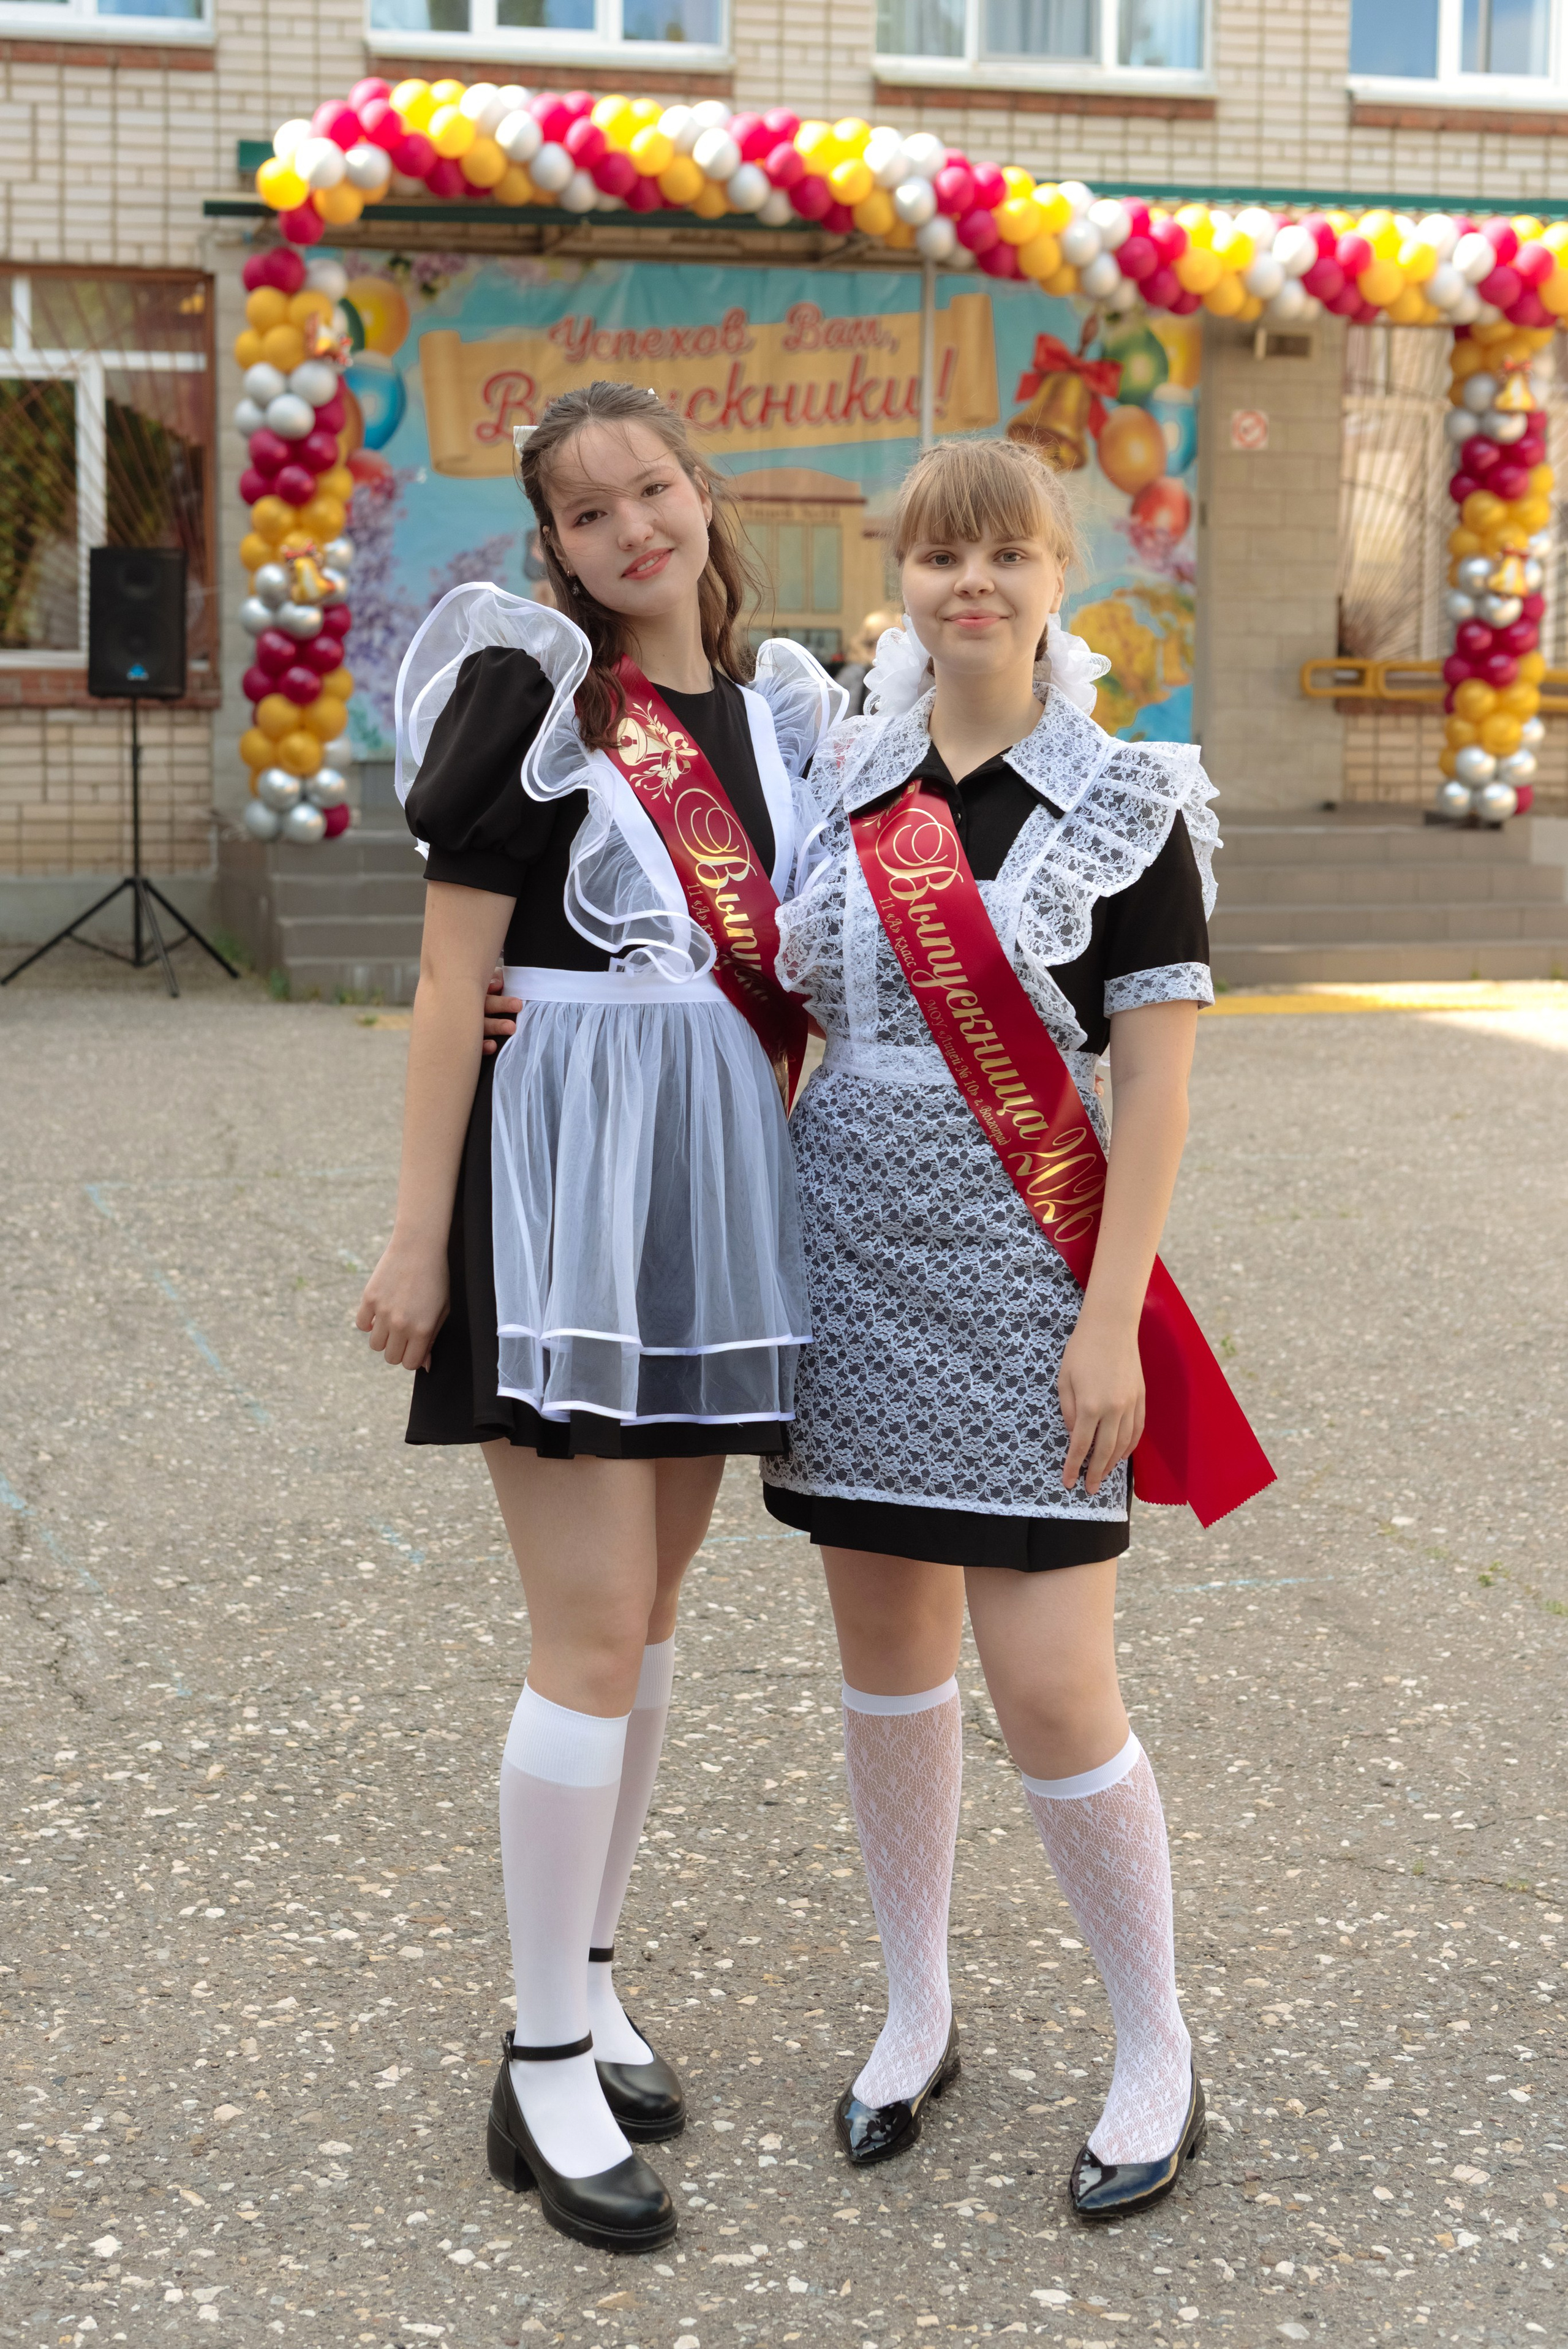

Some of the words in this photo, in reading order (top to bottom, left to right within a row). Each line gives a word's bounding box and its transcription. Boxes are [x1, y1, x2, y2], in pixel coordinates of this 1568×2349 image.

[549, 306, 748, 363] Успехов
[782, 301, 898, 353] Вам,
[686, 882, 704, 897] 11
[878, 896, 896, 911] 11
[894, 935, 917, 968] класс
[875, 807, 1049, 1141] Выпускница
[1007, 1126, 1106, 1243] 2026
[924, 999, 948, 1028] МОУ
[937, 1030, 965, 1066] «Лицей
[956, 1065, 972, 1080] №
[963, 1079, 981, 1096] 10»
[974, 1098, 984, 1107] г.
[979, 1105, 1012, 1146] Волгоград
